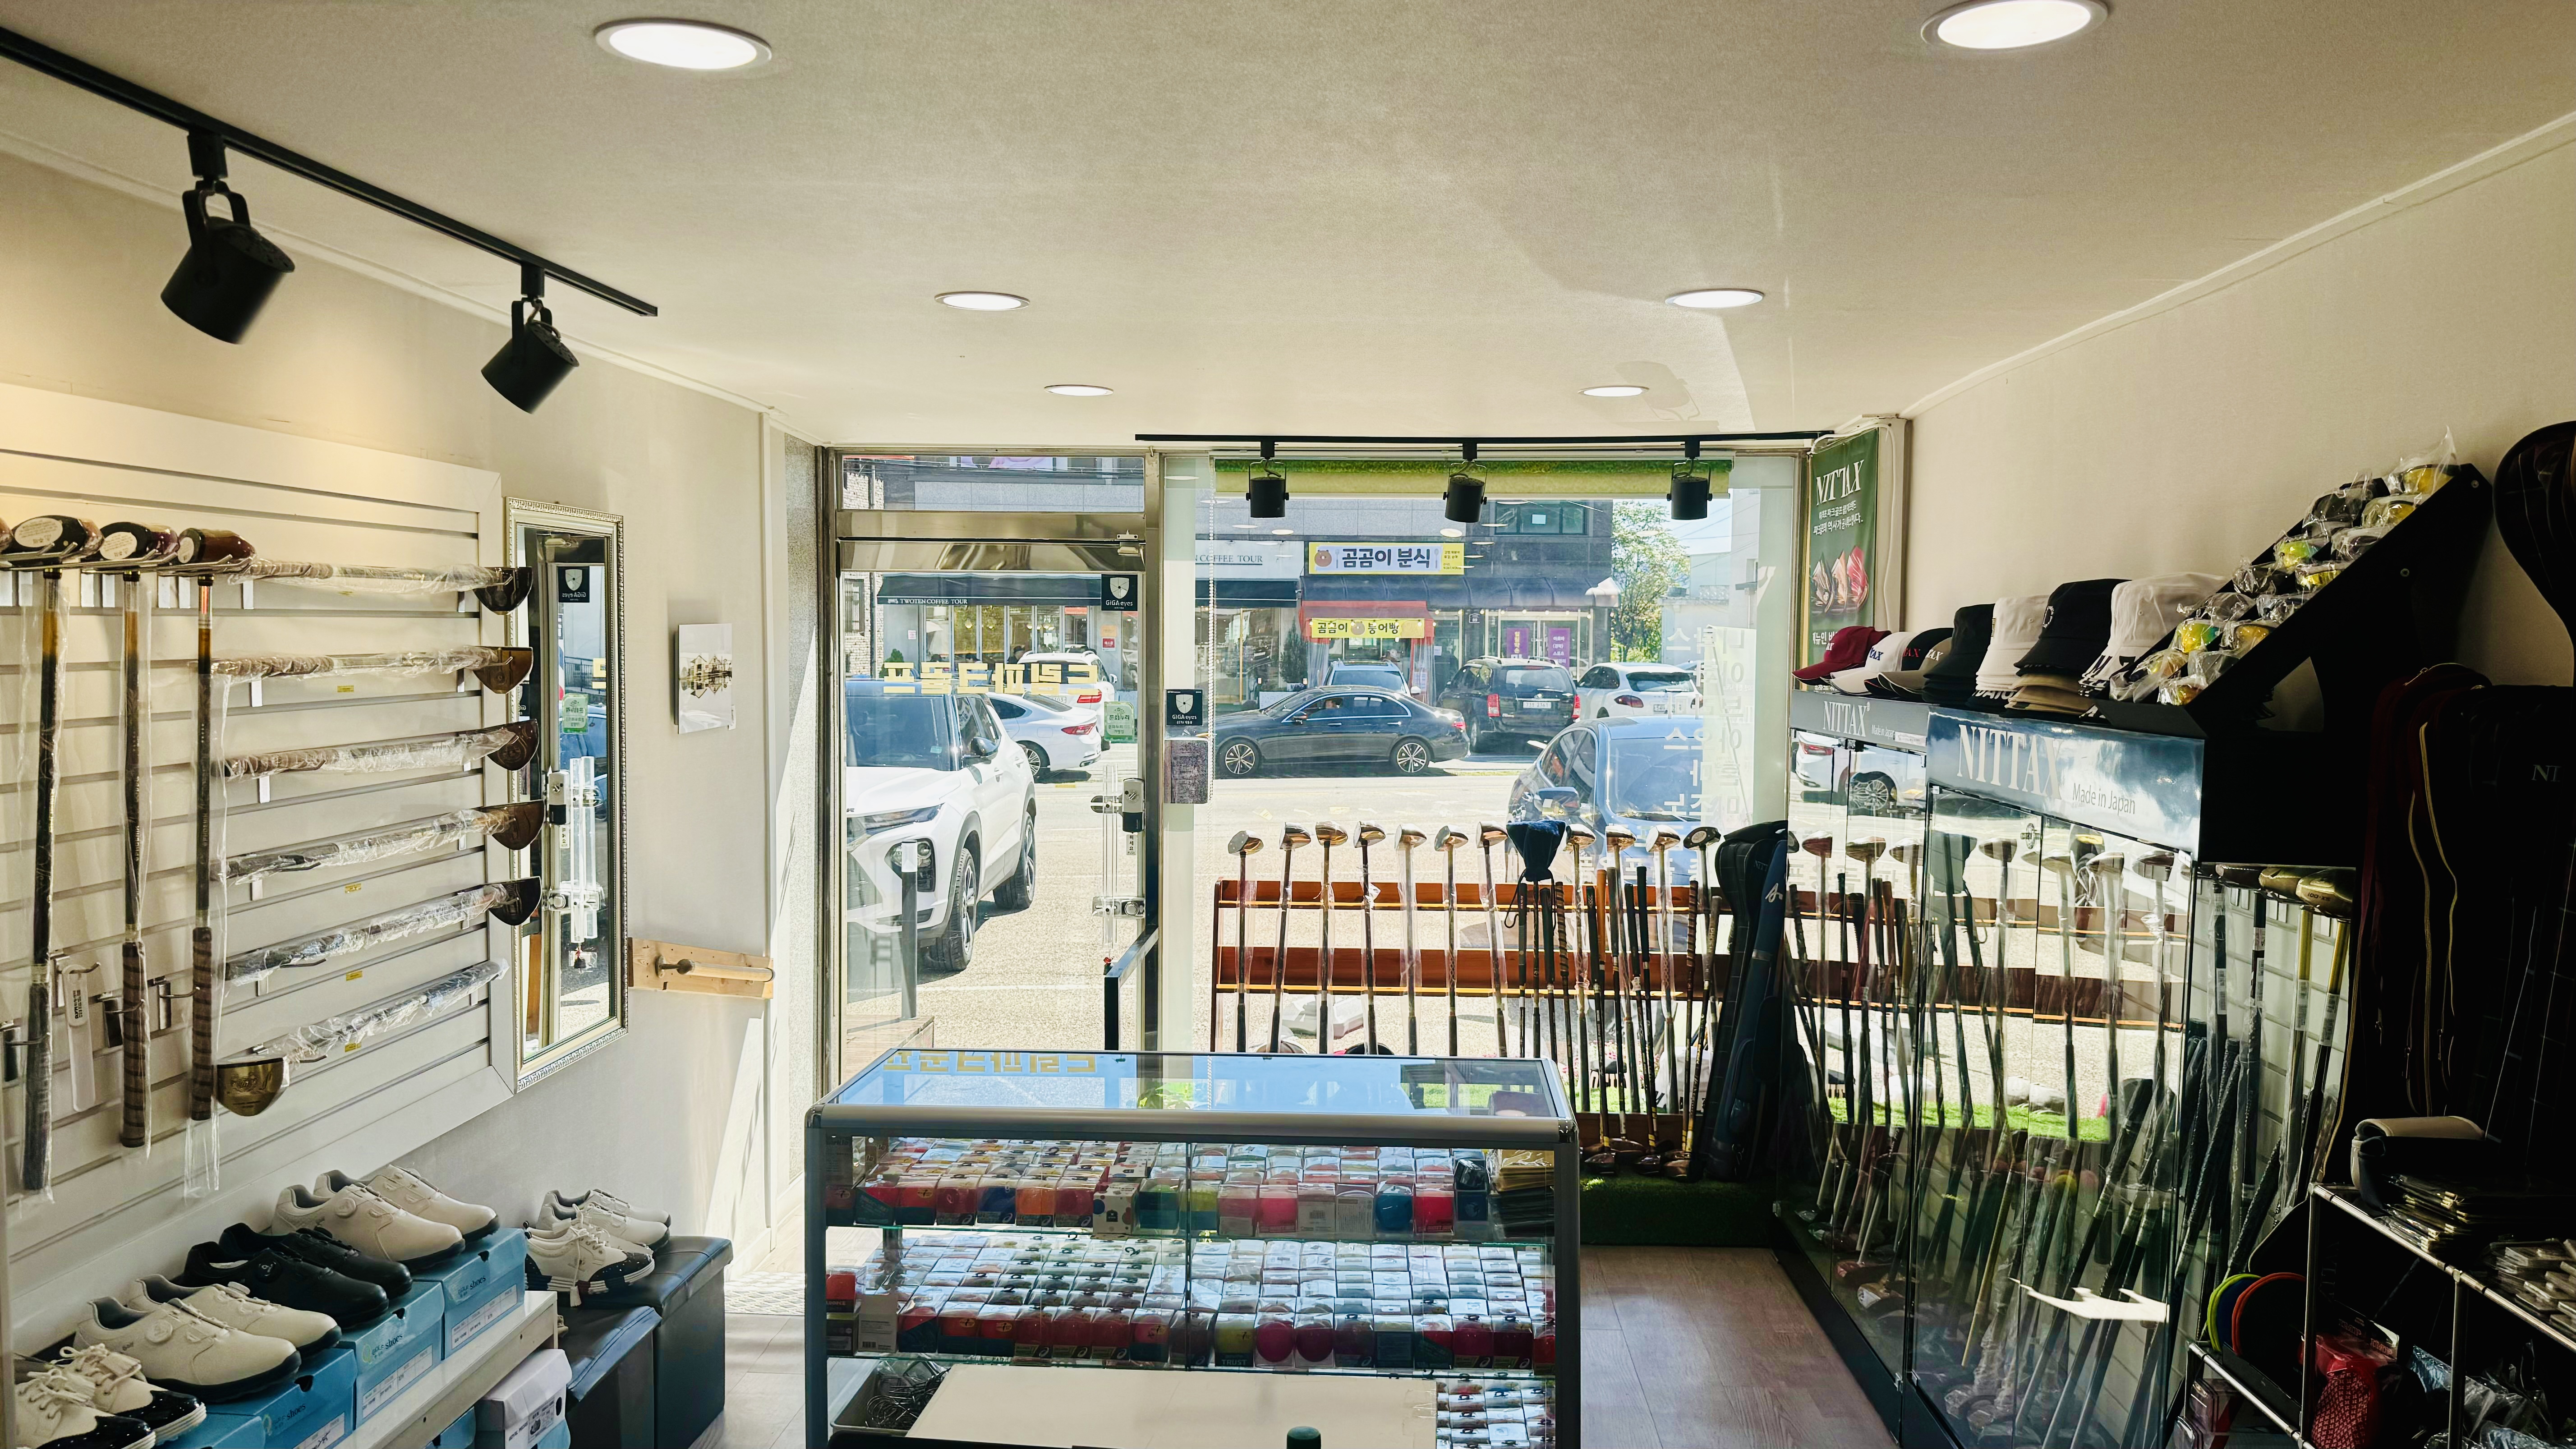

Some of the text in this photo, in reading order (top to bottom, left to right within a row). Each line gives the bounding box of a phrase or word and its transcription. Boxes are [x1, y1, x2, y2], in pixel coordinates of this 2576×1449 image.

[1816, 459, 1864, 506] NITTAX
[1342, 548, 1430, 568] 곰곰이 분식
[1317, 622, 1348, 634] 곰곰이
[1823, 701, 1866, 737] NITTAX
[1957, 724, 2135, 816] NITTAX Made in Japan
[470, 1275, 487, 1290] shoes
[386, 1333, 403, 1349] shoes
[287, 1403, 306, 1420] shoes
